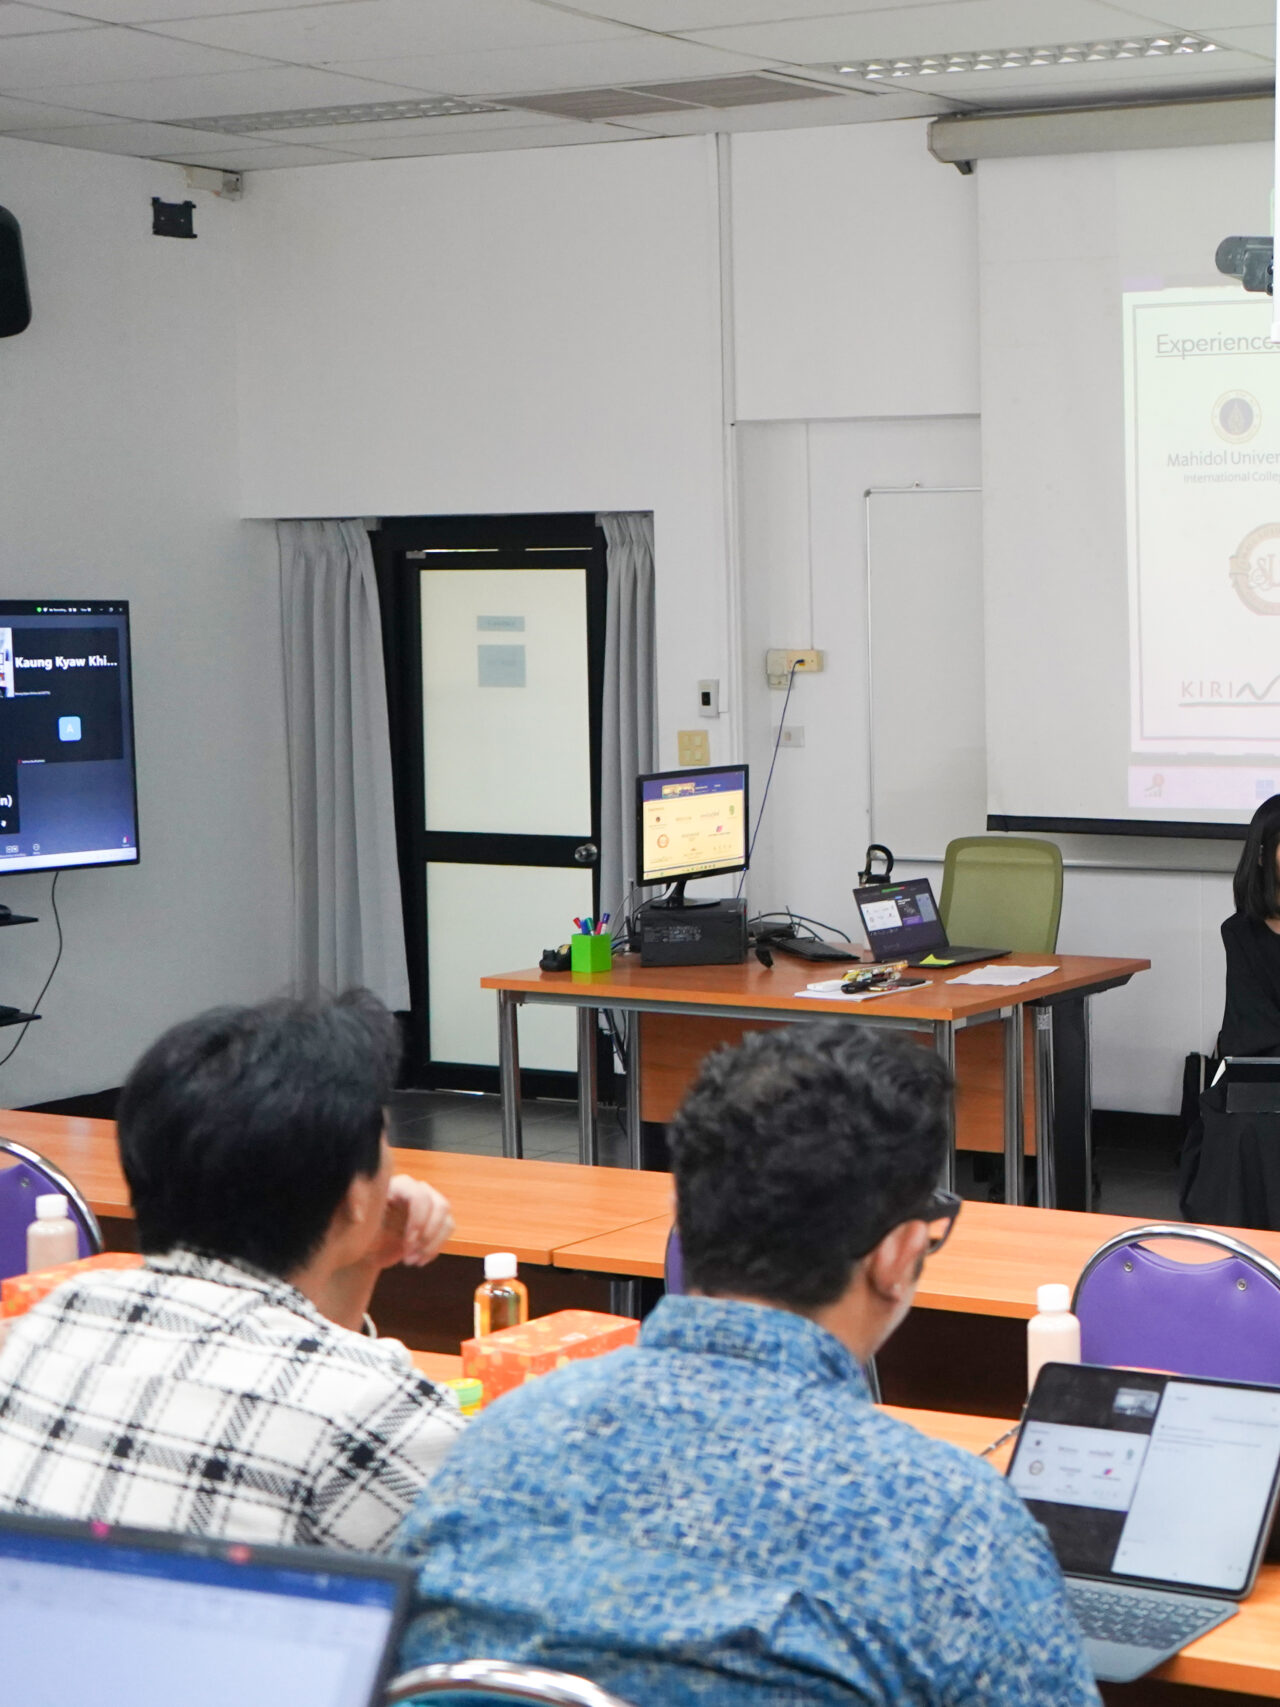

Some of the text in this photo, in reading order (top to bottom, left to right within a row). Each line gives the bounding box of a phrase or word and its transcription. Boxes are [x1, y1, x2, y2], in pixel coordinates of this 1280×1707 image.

[1167, 450, 1227, 467] Mahidol
[1184, 472, 1250, 484] International
[14, 655, 118, 670] Kaung Kyaw Khi...
